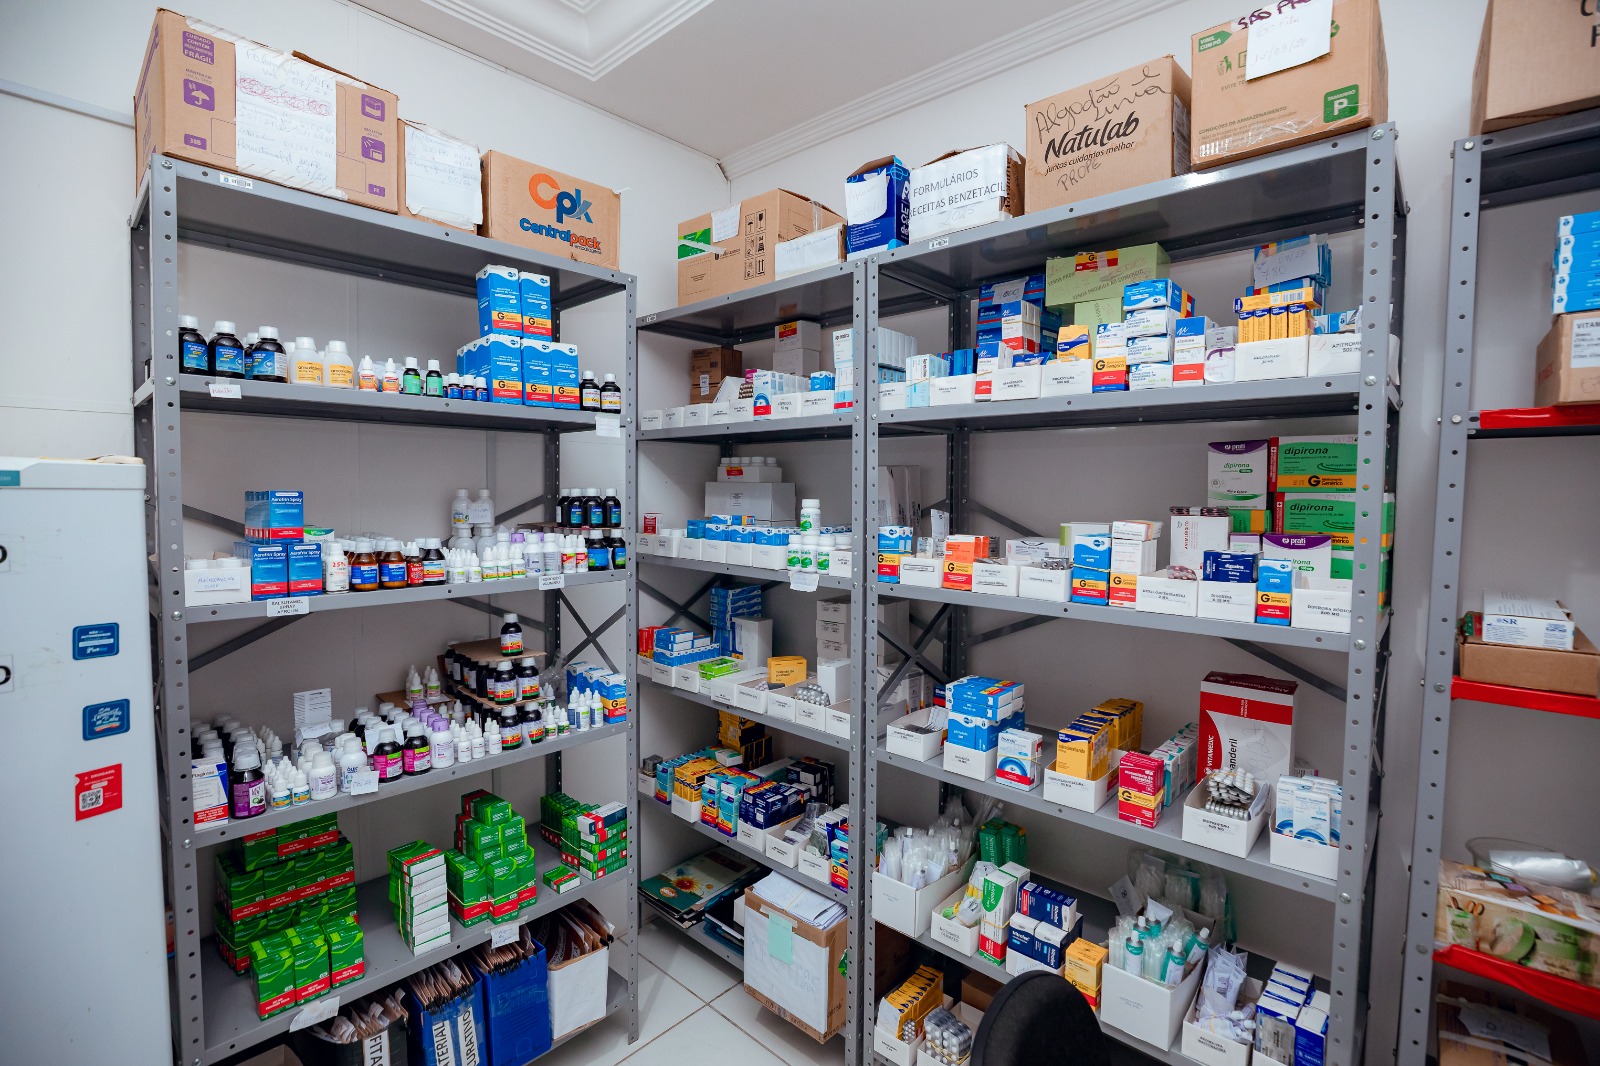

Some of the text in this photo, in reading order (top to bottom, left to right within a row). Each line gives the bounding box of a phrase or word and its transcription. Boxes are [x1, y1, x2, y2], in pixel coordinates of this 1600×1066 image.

[1334, 98, 1347, 116] P
[1044, 111, 1140, 164] Natulab
[1068, 150, 1105, 167] cuidamos
[1105, 141, 1135, 156] melhor
[913, 168, 979, 197] FORMULÁRIOS
[949, 180, 1006, 205] BENZETACIL
[519, 217, 601, 250] Centralpack
[1095, 360, 1106, 371] G
[1284, 447, 1329, 456] dipirona
[1224, 463, 1250, 472] dipirona
[1307, 475, 1321, 487] G
[1289, 503, 1335, 513] dipirona
[1260, 593, 1271, 603] G
[1228, 738, 1238, 772] anderil
[435, 1020, 453, 1066] ATERIAL
[462, 1012, 477, 1066] URATIVO
